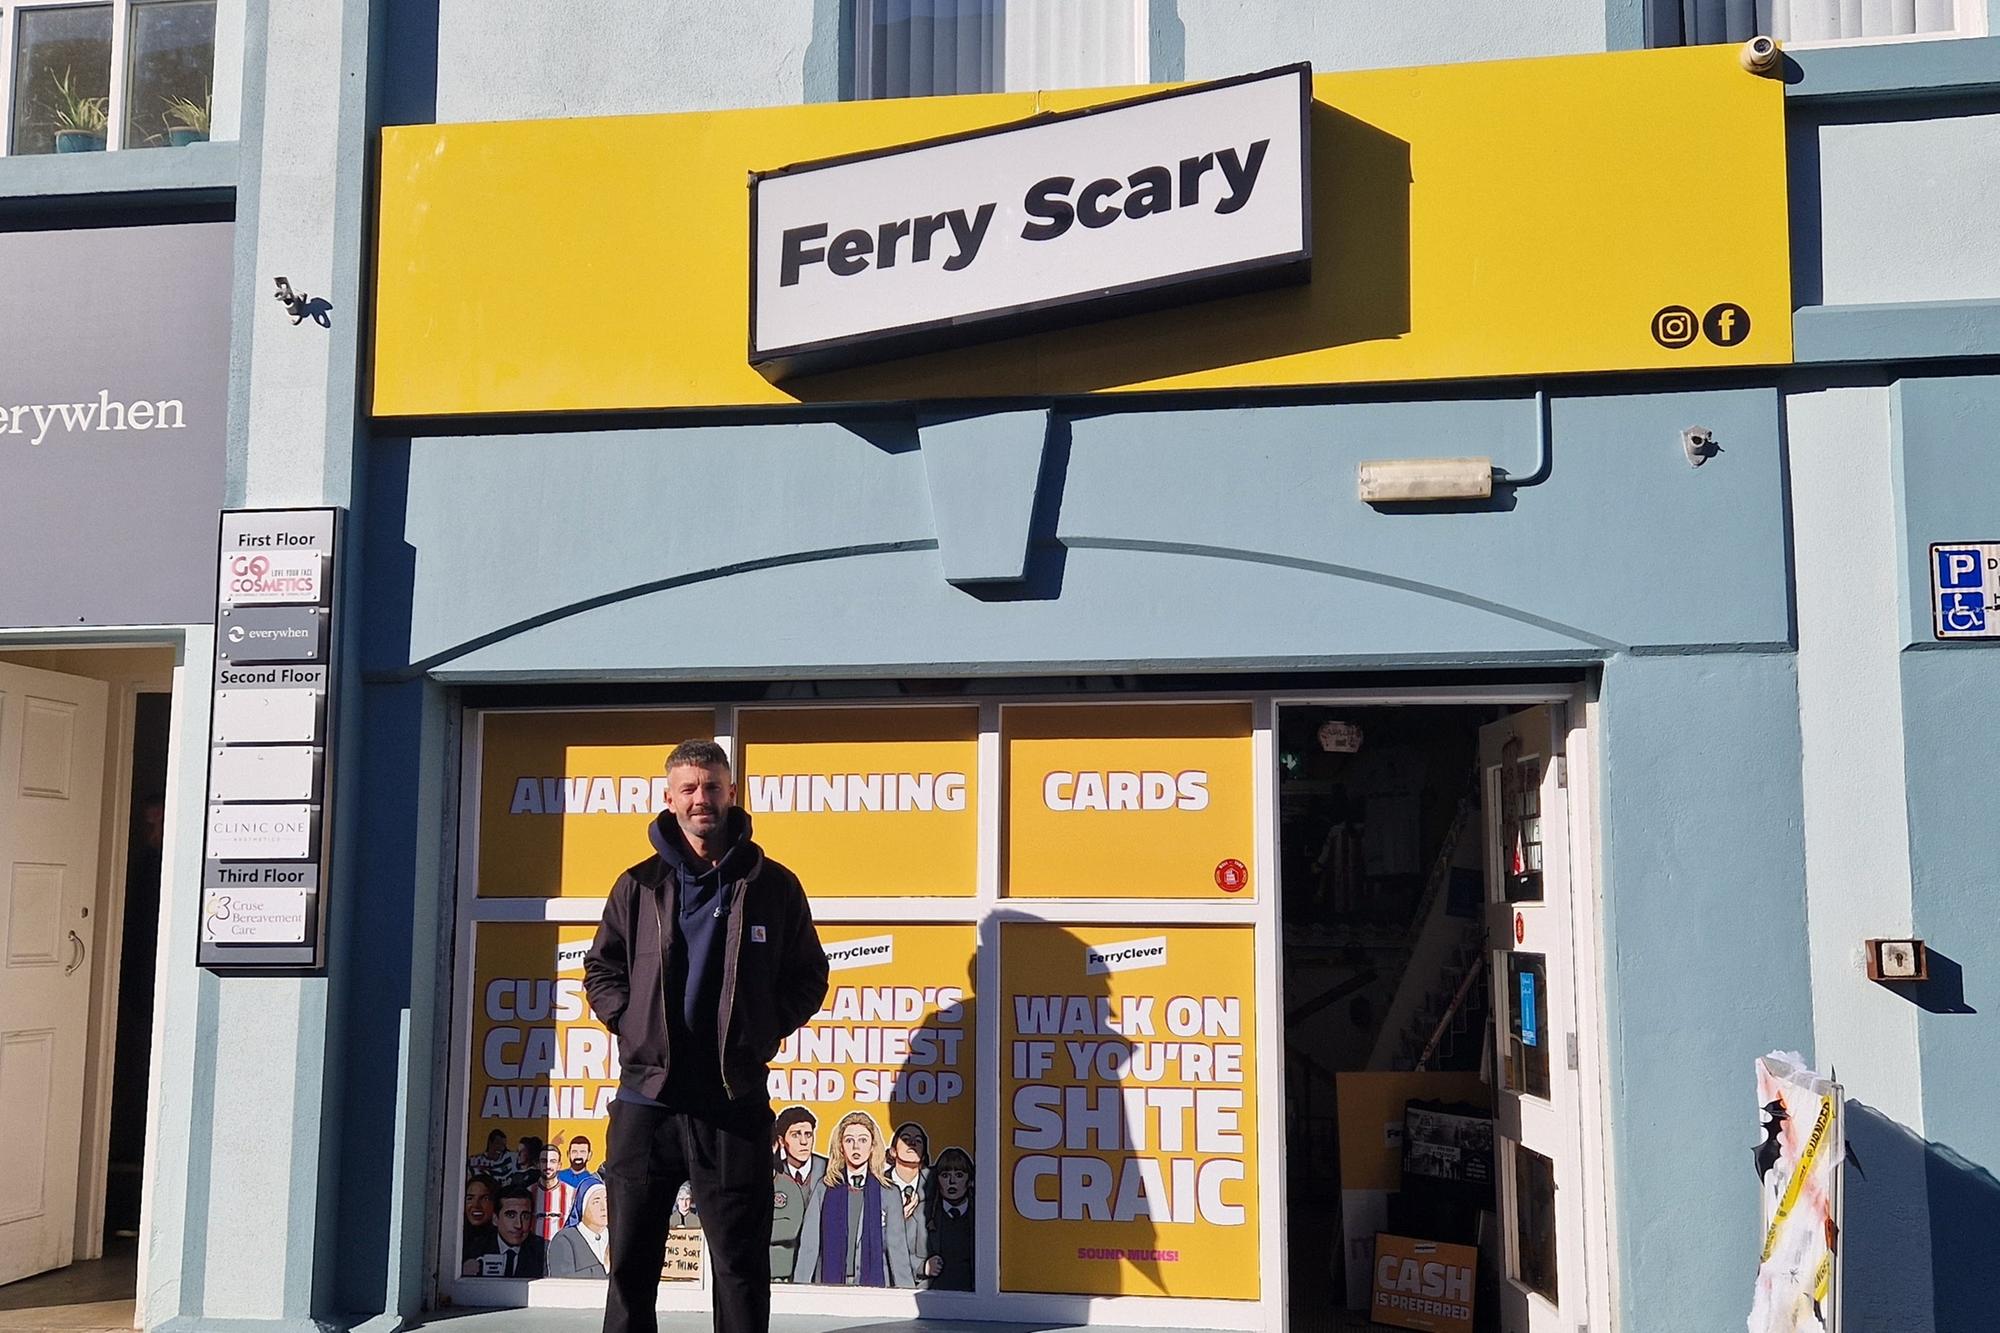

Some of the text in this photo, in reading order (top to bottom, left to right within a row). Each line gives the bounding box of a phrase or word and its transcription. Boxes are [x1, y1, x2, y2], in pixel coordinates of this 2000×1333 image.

[780, 138, 1270, 287] Ferry Scary
[238, 531, 316, 547] First Floor
[271, 568, 313, 577] LOVE YOUR FACE
[1949, 554, 1975, 585] P
[231, 577, 313, 593] COSMETICS
[248, 626, 309, 641] everywhen
[220, 669, 321, 685] Second Floor
[748, 772, 966, 812] WINNING
[1043, 770, 1209, 811] CARDS
[214, 822, 305, 833] CLINIC ONE
[218, 868, 305, 883] Third Floor
[232, 901, 264, 911] Cruse
[232, 914, 302, 924] Bereavement
[231, 925, 256, 936] Care
[1089, 945, 1164, 965] FerryClever
[485, 978, 597, 1022] CUS
[1012, 994, 1241, 1038] WALK ON
[483, 1026, 621, 1080] CAR
[1011, 1040, 1243, 1083] IF YOU'RE
[853, 1068, 964, 1104] SHOP
[1011, 1084, 1244, 1153] SHITE
[1011, 1154, 1247, 1227] CRAIC
[683, 1247, 701, 1258] SORT
[1077, 1247, 1179, 1262] SOUND MUCKS!
[664, 1259, 698, 1271] OF THING
[1377, 1254, 1473, 1302] CASH
[1375, 1291, 1470, 1320] IS PREFERRED
